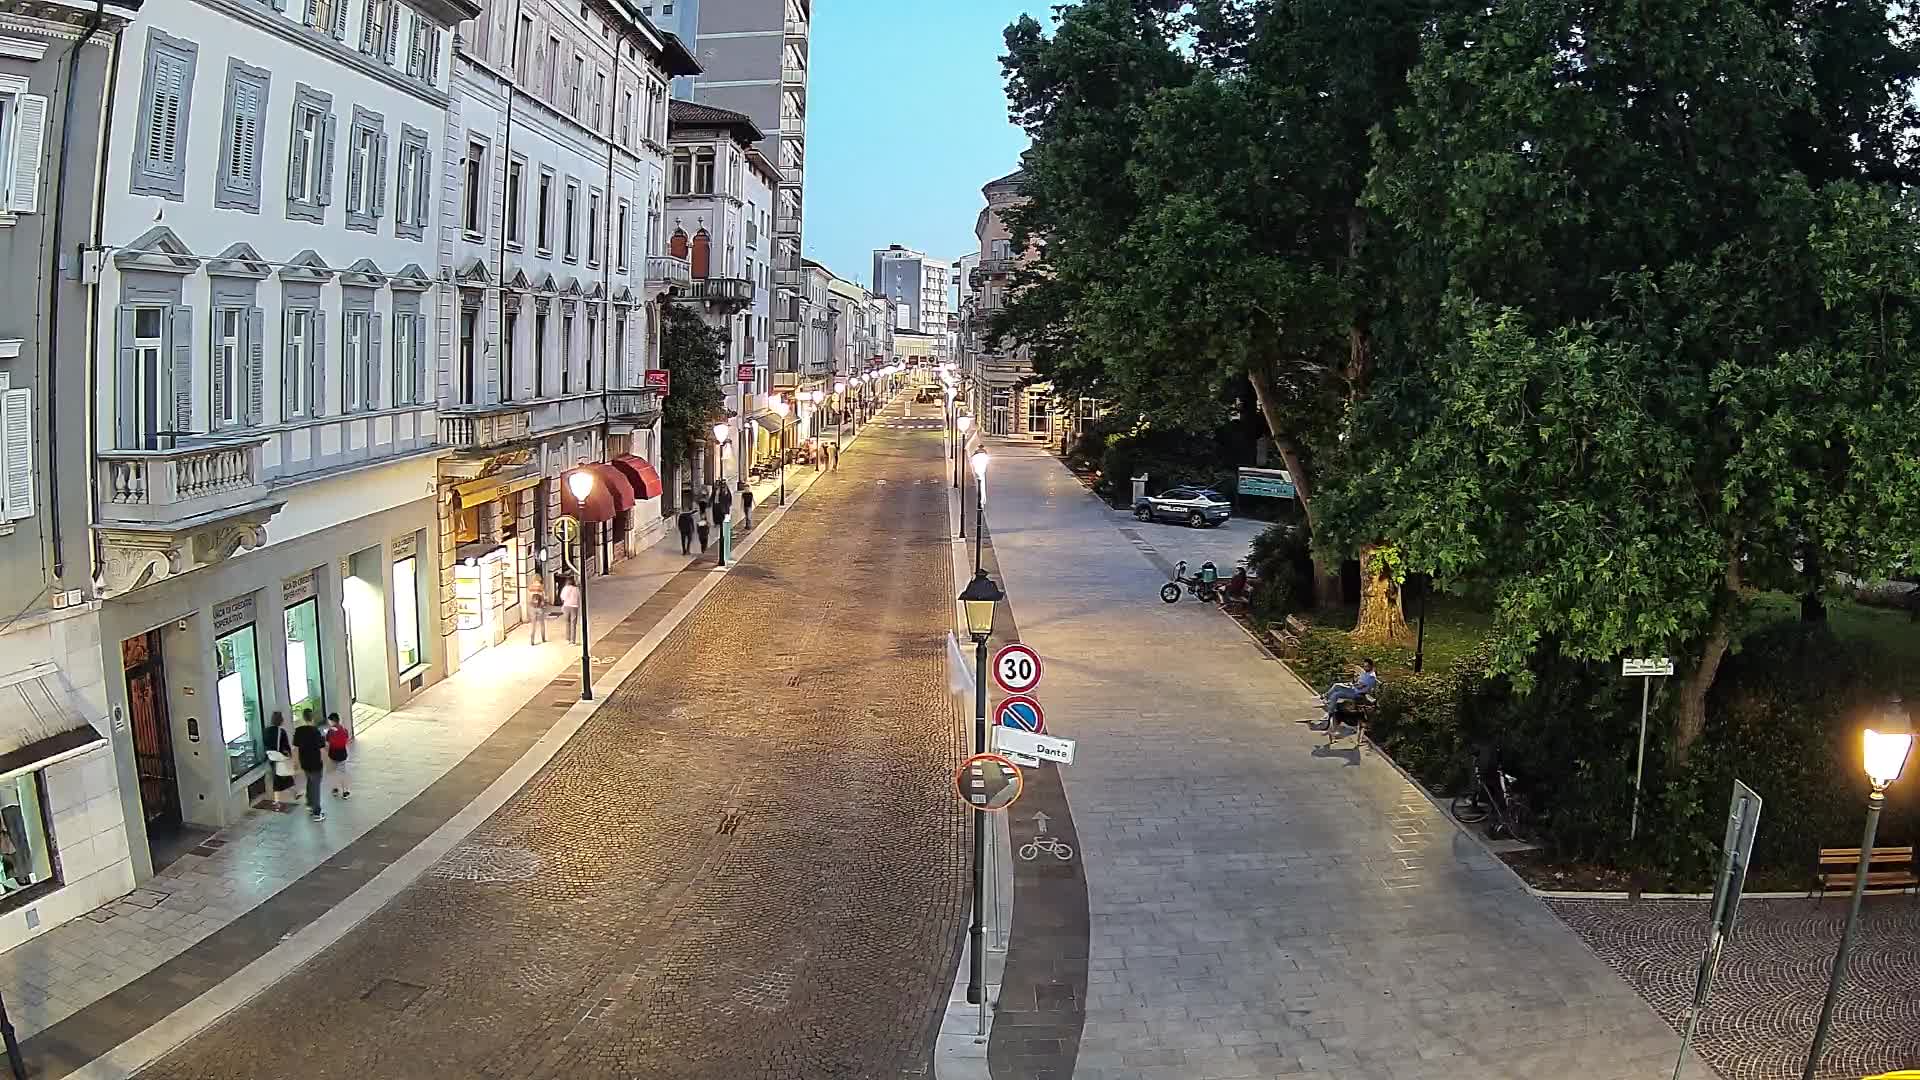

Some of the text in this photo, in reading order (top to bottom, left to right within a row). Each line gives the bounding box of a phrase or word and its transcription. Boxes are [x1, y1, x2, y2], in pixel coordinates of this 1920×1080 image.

[1157, 504, 1188, 512] POLIZIA
[1004, 658, 1032, 680] 30
[1037, 744, 1067, 758] Dante
